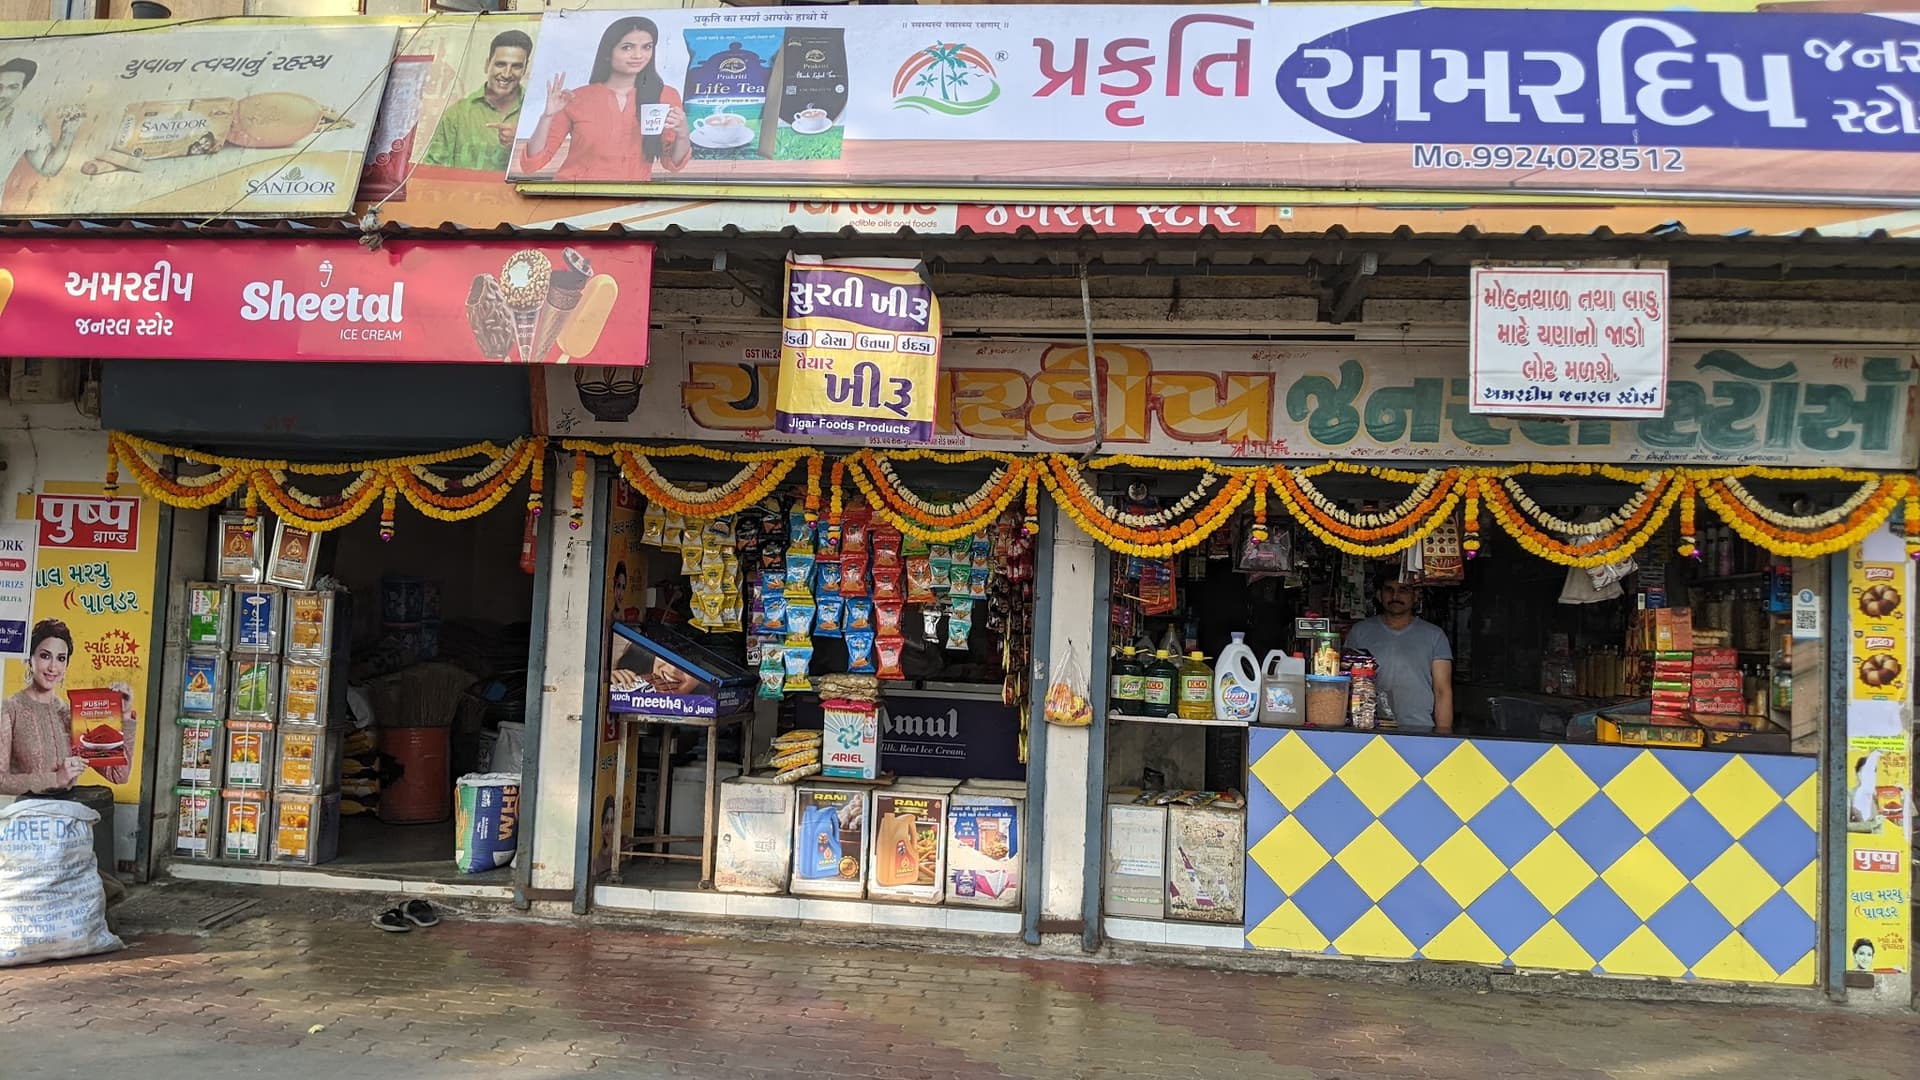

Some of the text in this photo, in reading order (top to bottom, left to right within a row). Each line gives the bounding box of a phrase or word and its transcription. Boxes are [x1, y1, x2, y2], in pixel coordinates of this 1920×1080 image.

[724, 13, 736, 22] का
[121, 50, 333, 79] યુવાન ત્વચાનું રહસ્ય
[1032, 13, 1255, 127] પ્રકૃતિ
[1297, 18, 1806, 127] અમરદિપ
[695, 82, 765, 97] Life Tea
[140, 119, 207, 132] SANTOOR
[1413, 144, 1685, 172] Mo.9924028512
[246, 179, 336, 196] SANTOOR
[878, 218, 892, 228] oils
[912, 219, 938, 228] foods
[65, 260, 194, 303] અમરદીપ
[240, 281, 404, 322] Sheetal
[790, 276, 929, 325] સુરતી ખીરૂ
[1484, 280, 1660, 321] મોહનથાળ તથા લાડુ
[75, 315, 174, 336] જનરલ સ્ટોર
[1498, 316, 1645, 348] માટે ચણાનો જાડો
[340, 329, 402, 341] ICE CREAM
[820, 333, 847, 347] ઢોસા
[745, 348, 760, 359] GST
[796, 352, 834, 370] તૈયાર
[1565, 353, 1620, 384] મળશે.
[825, 361, 913, 418] ખીરૂ
[1484, 386, 1553, 402] અમરદીપ
[1559, 391, 1611, 404] જનરલ
[789, 418, 911, 435] Jigar Foods Products
[41, 498, 136, 544] पुष्प
[80, 591, 138, 613] પાવડર
[84, 638, 111, 653] સ્વાદ
[91, 655, 139, 670] સુપરસ્ટાર
[1187, 680, 1208, 689] ECO
[1694, 679, 1738, 689] GOLDEN
[631, 695, 682, 710] meetha
[683, 704, 693, 713] ho
[831, 752, 864, 763] ARIEL
[899, 744, 919, 753] Real
[920, 744, 934, 754] Ice
[814, 793, 847, 801] RANI
[894, 799, 928, 808] RANI
[1855, 850, 1897, 869] पुष्प
[1851, 889, 1874, 902] લાલ
[1863, 905, 1898, 919] પાવડર
